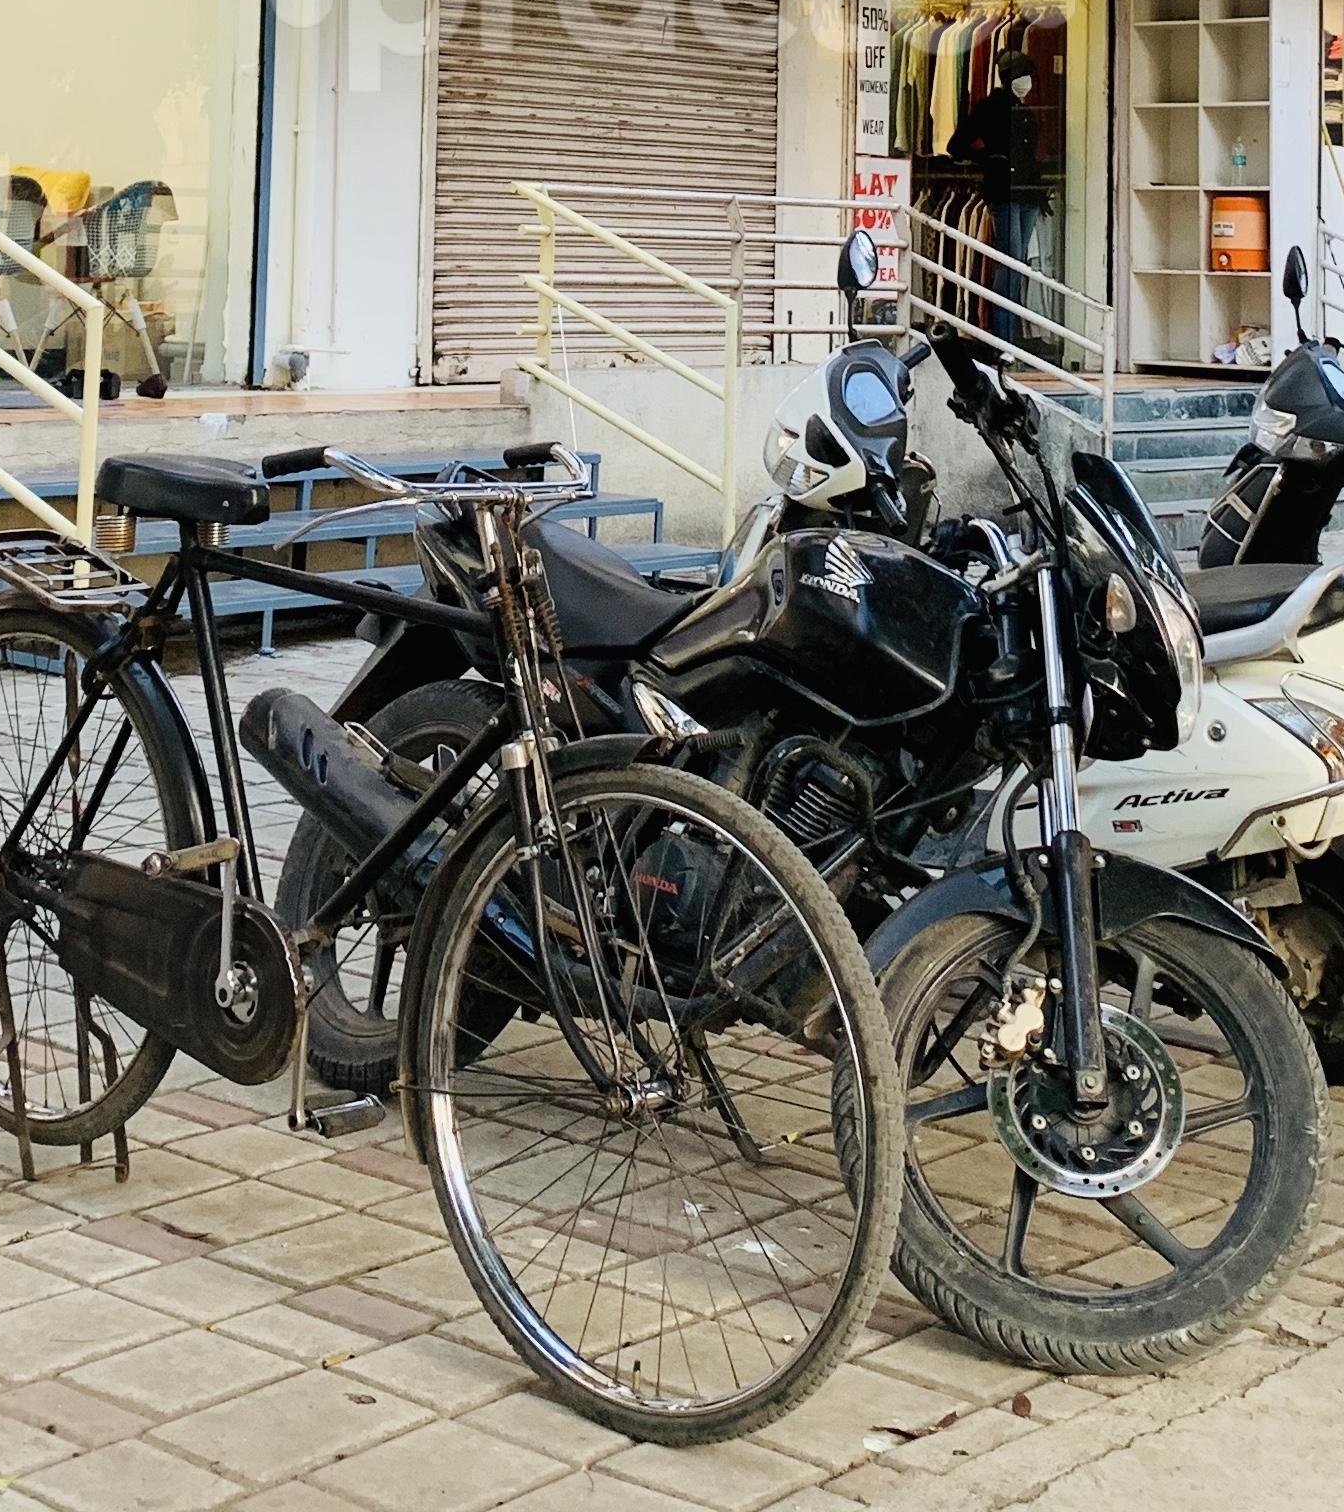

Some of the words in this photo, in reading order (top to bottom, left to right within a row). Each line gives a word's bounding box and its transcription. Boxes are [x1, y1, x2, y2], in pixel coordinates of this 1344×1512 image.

[862, 7, 889, 32] 50%
[865, 46, 886, 69] OFF
[859, 80, 888, 95] WOMENS
[862, 119, 884, 136] WEAR
[855, 173, 898, 198] LAT
[799, 573, 860, 604] HONDA
[1113, 788, 1230, 811] Activa
